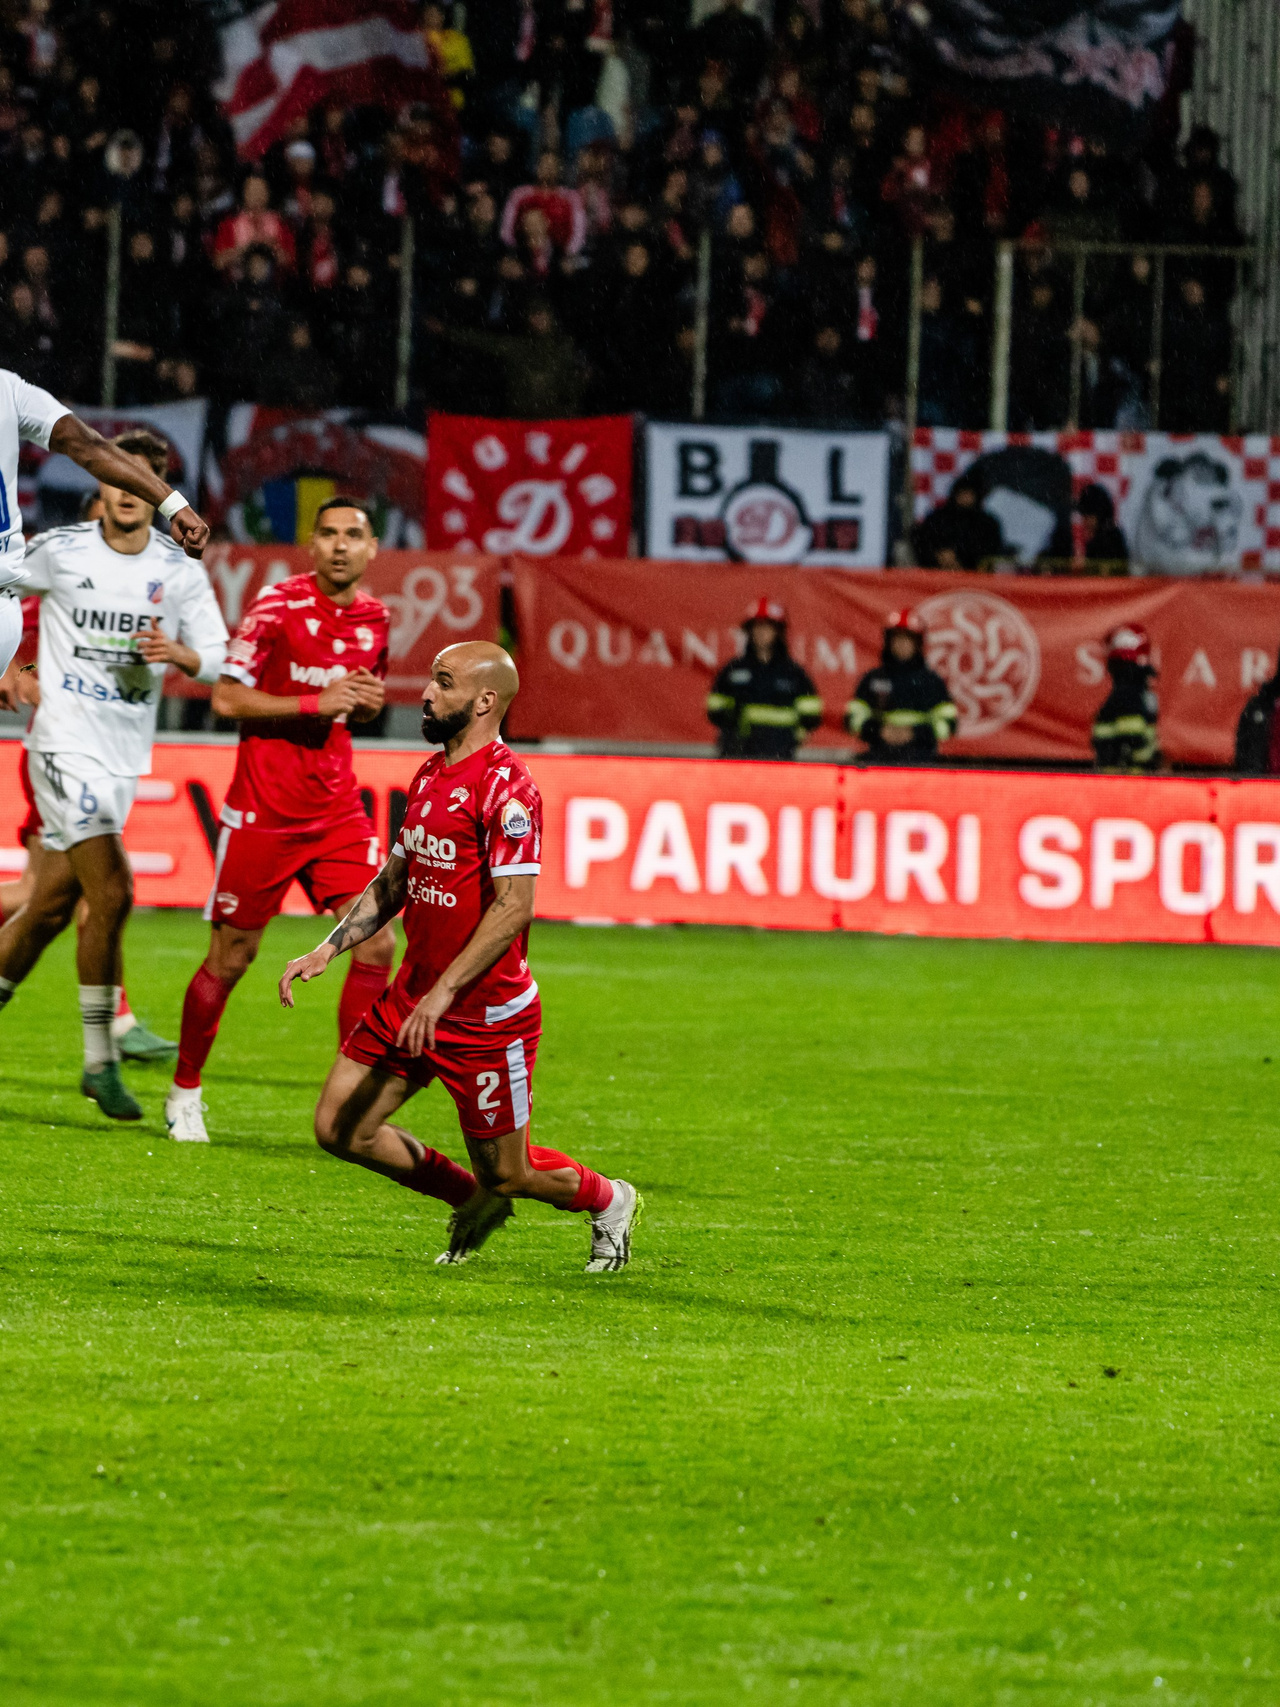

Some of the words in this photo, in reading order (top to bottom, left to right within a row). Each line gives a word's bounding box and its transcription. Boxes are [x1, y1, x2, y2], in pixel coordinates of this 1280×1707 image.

[80, 782, 98, 815] 6
[433, 860, 456, 870] SPORT
[565, 797, 981, 905] PARIURI
[1018, 814, 1280, 916] SPOR
[476, 1071, 501, 1110] 2
